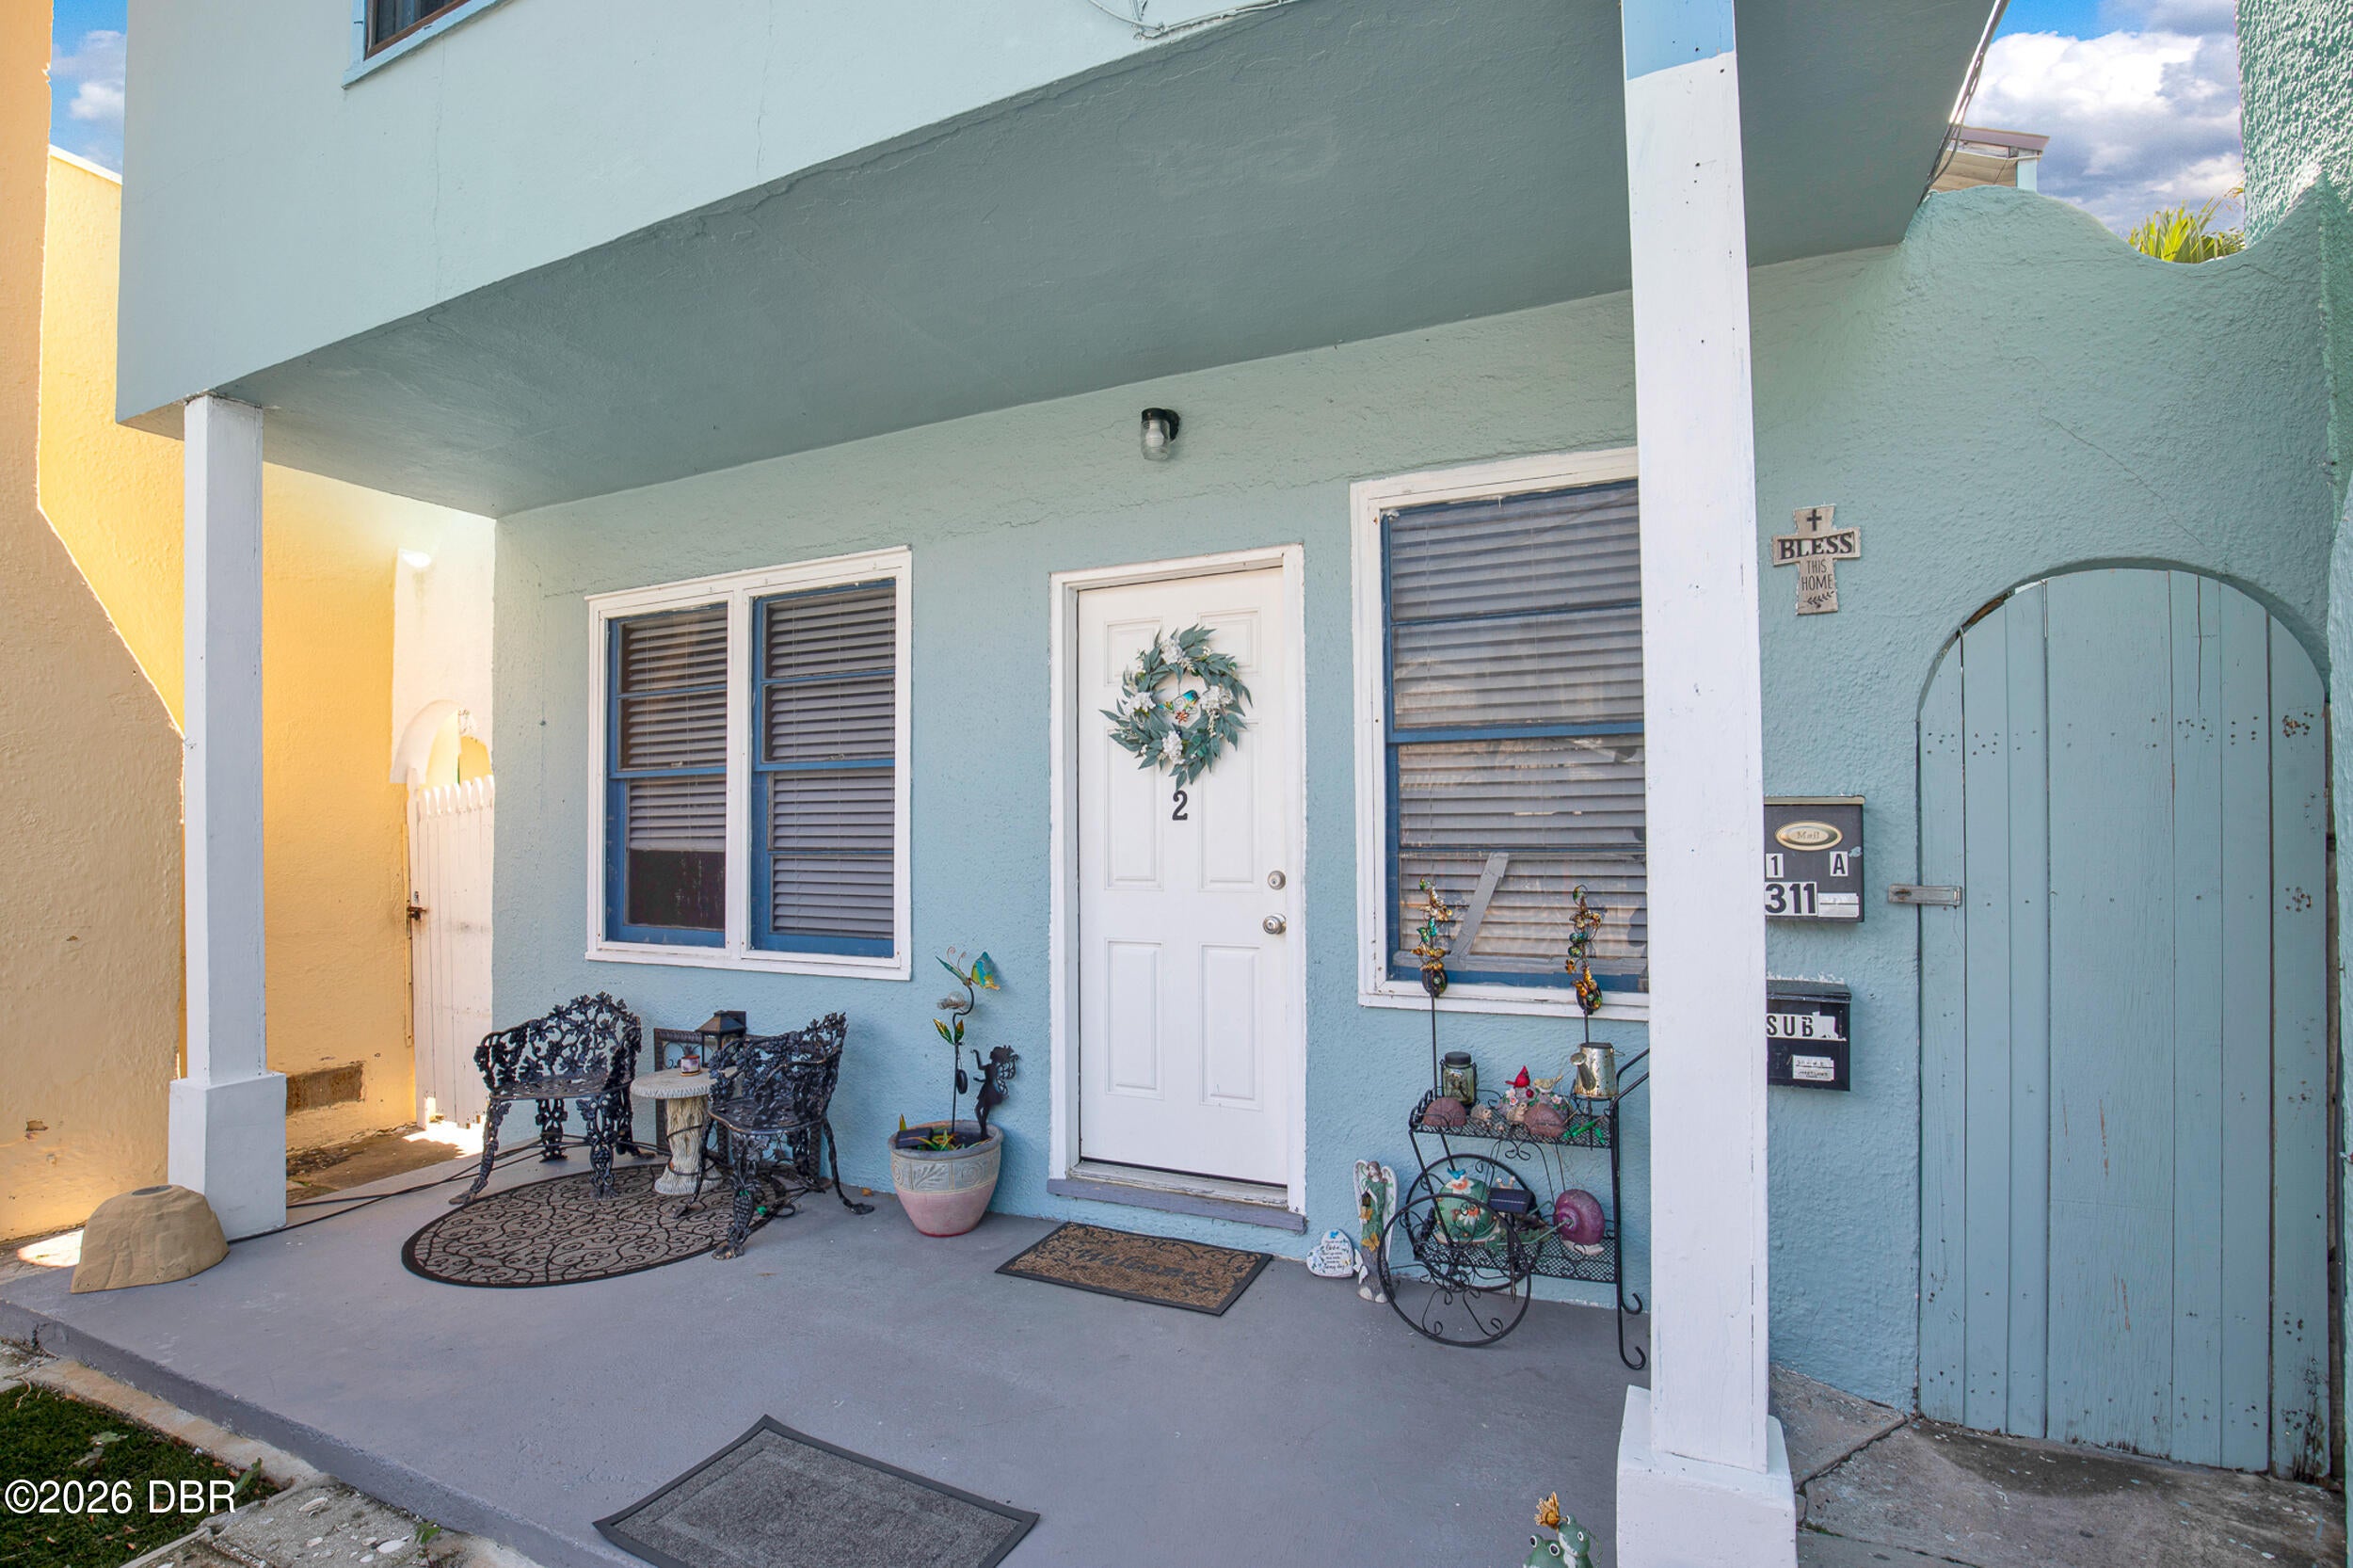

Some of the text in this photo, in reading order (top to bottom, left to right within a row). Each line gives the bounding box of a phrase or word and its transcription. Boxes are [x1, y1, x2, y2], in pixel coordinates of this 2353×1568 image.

[1778, 533, 1853, 560] BLESS
[1807, 559, 1828, 574] THIS
[1801, 573, 1833, 591] HOME
[1172, 790, 1189, 821] 2
[1770, 853, 1846, 876] 1 A
[1765, 883, 1817, 914] 311
[1767, 1015, 1814, 1037] SUB
